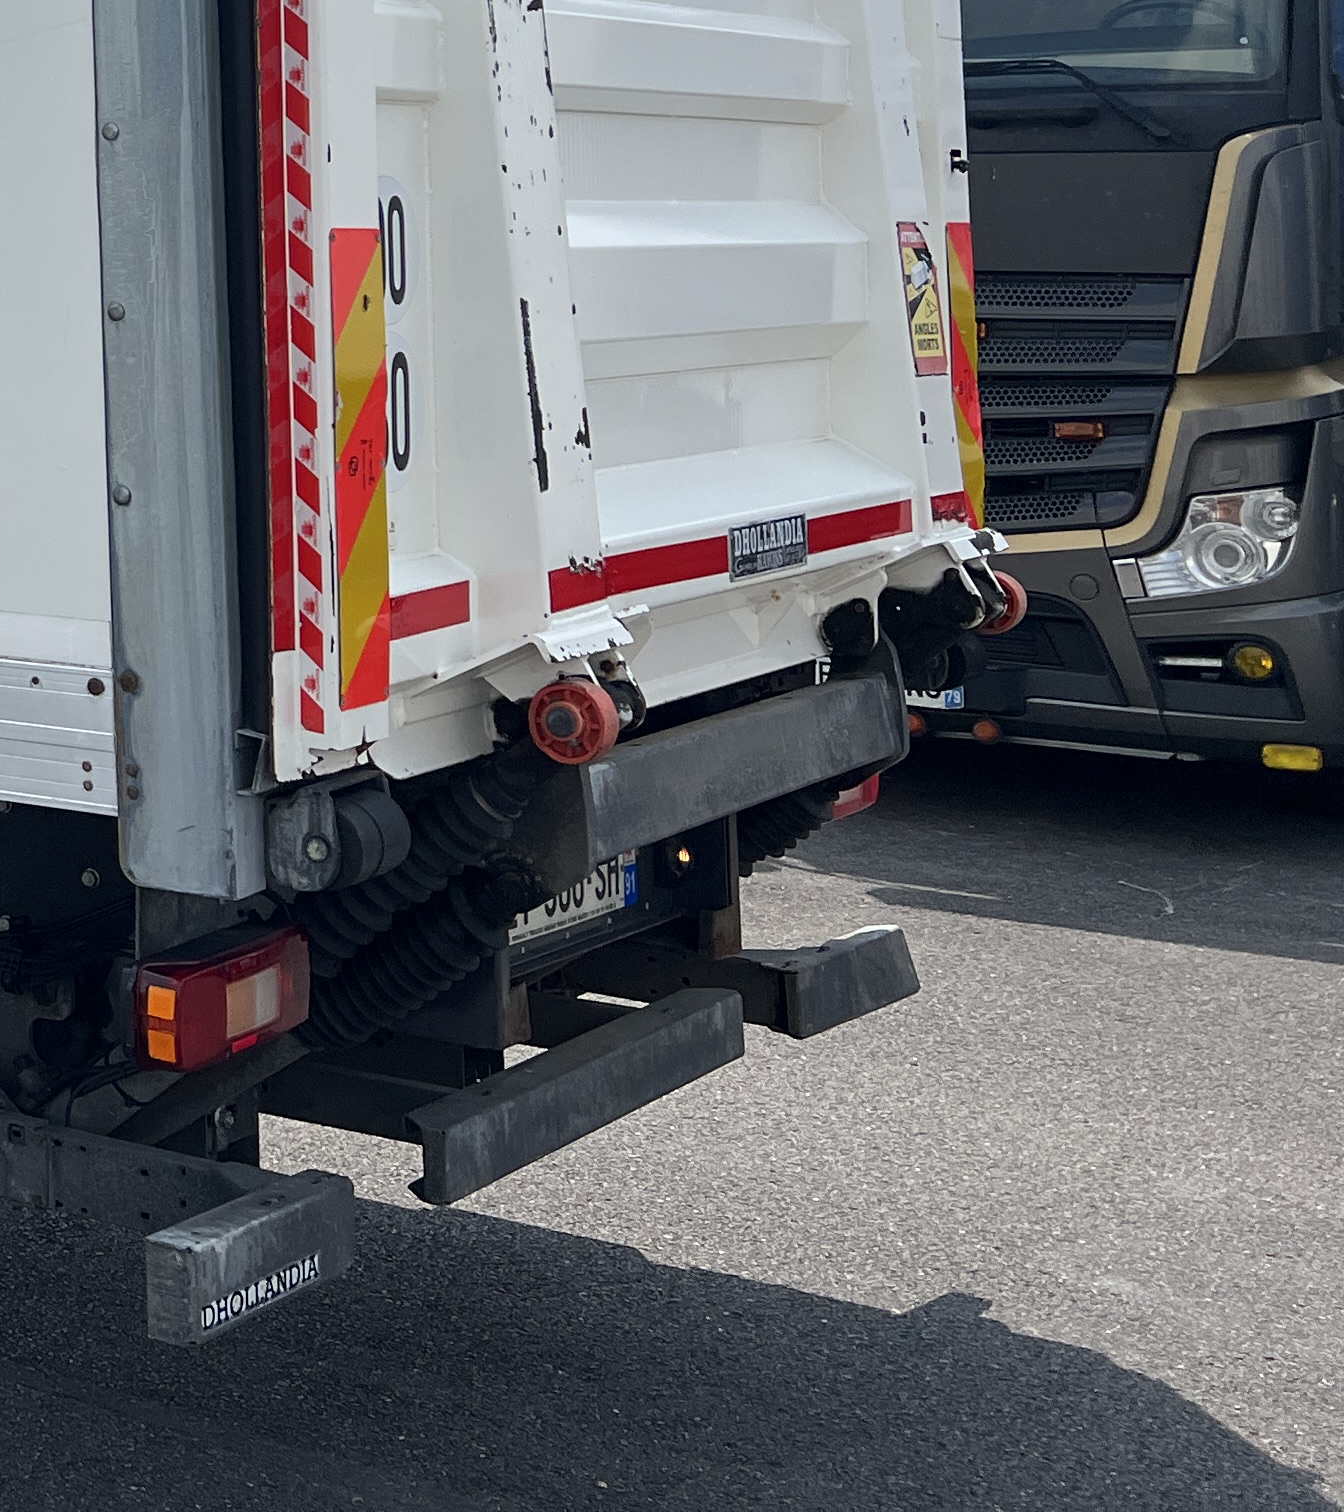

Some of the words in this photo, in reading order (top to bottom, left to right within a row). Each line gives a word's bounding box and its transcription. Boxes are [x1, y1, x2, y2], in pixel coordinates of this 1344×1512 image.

[914, 322, 939, 336] ANGLES
[917, 337, 940, 351] MORTS
[733, 517, 804, 557] DHOLLANDIA
[945, 690, 961, 704] 79
[625, 870, 636, 896] 91
[200, 1253, 320, 1331] DHOLLANDIA
